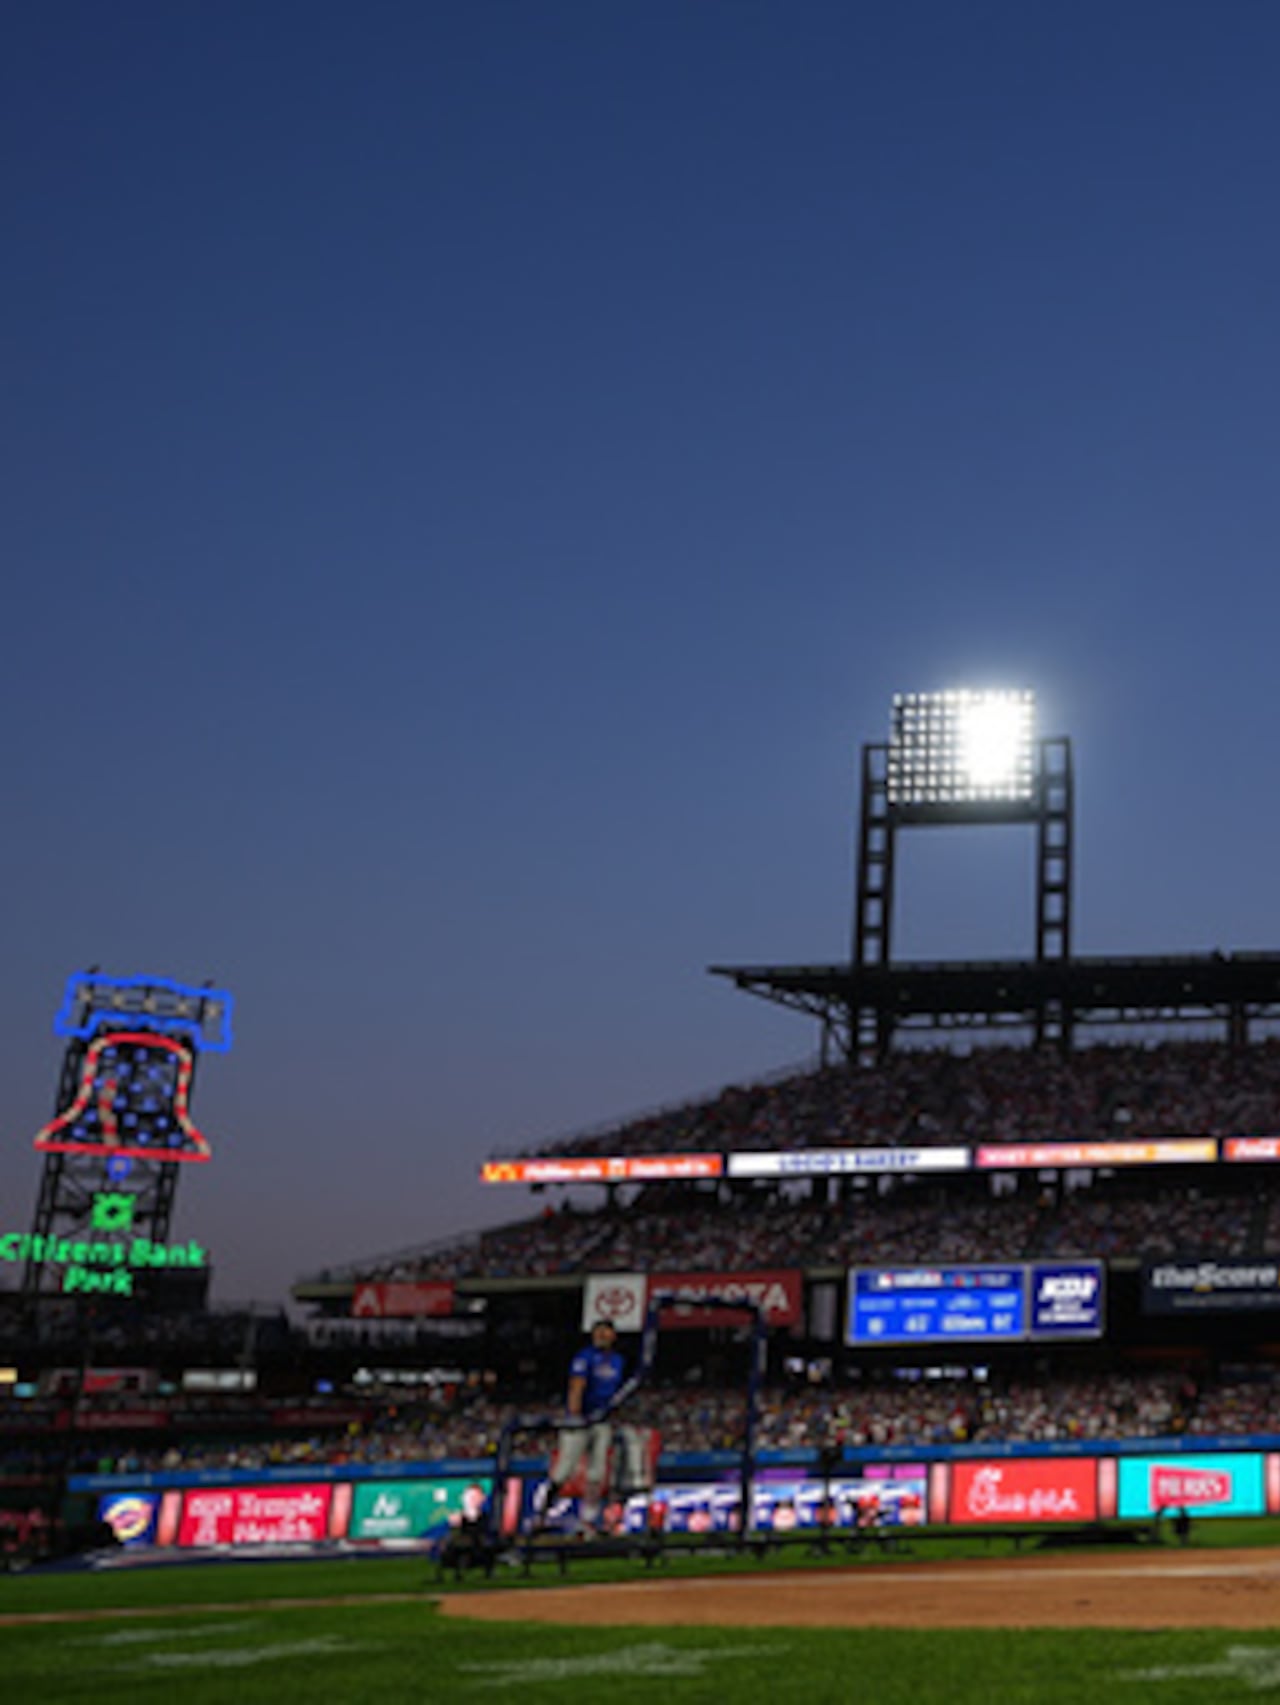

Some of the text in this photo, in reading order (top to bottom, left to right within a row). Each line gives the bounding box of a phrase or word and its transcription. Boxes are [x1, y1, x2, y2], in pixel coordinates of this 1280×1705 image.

[0, 1233, 206, 1268] Citizens Bank
[62, 1264, 134, 1297] Park
[236, 1491, 323, 1520] Temple
[232, 1517, 314, 1542] Health
